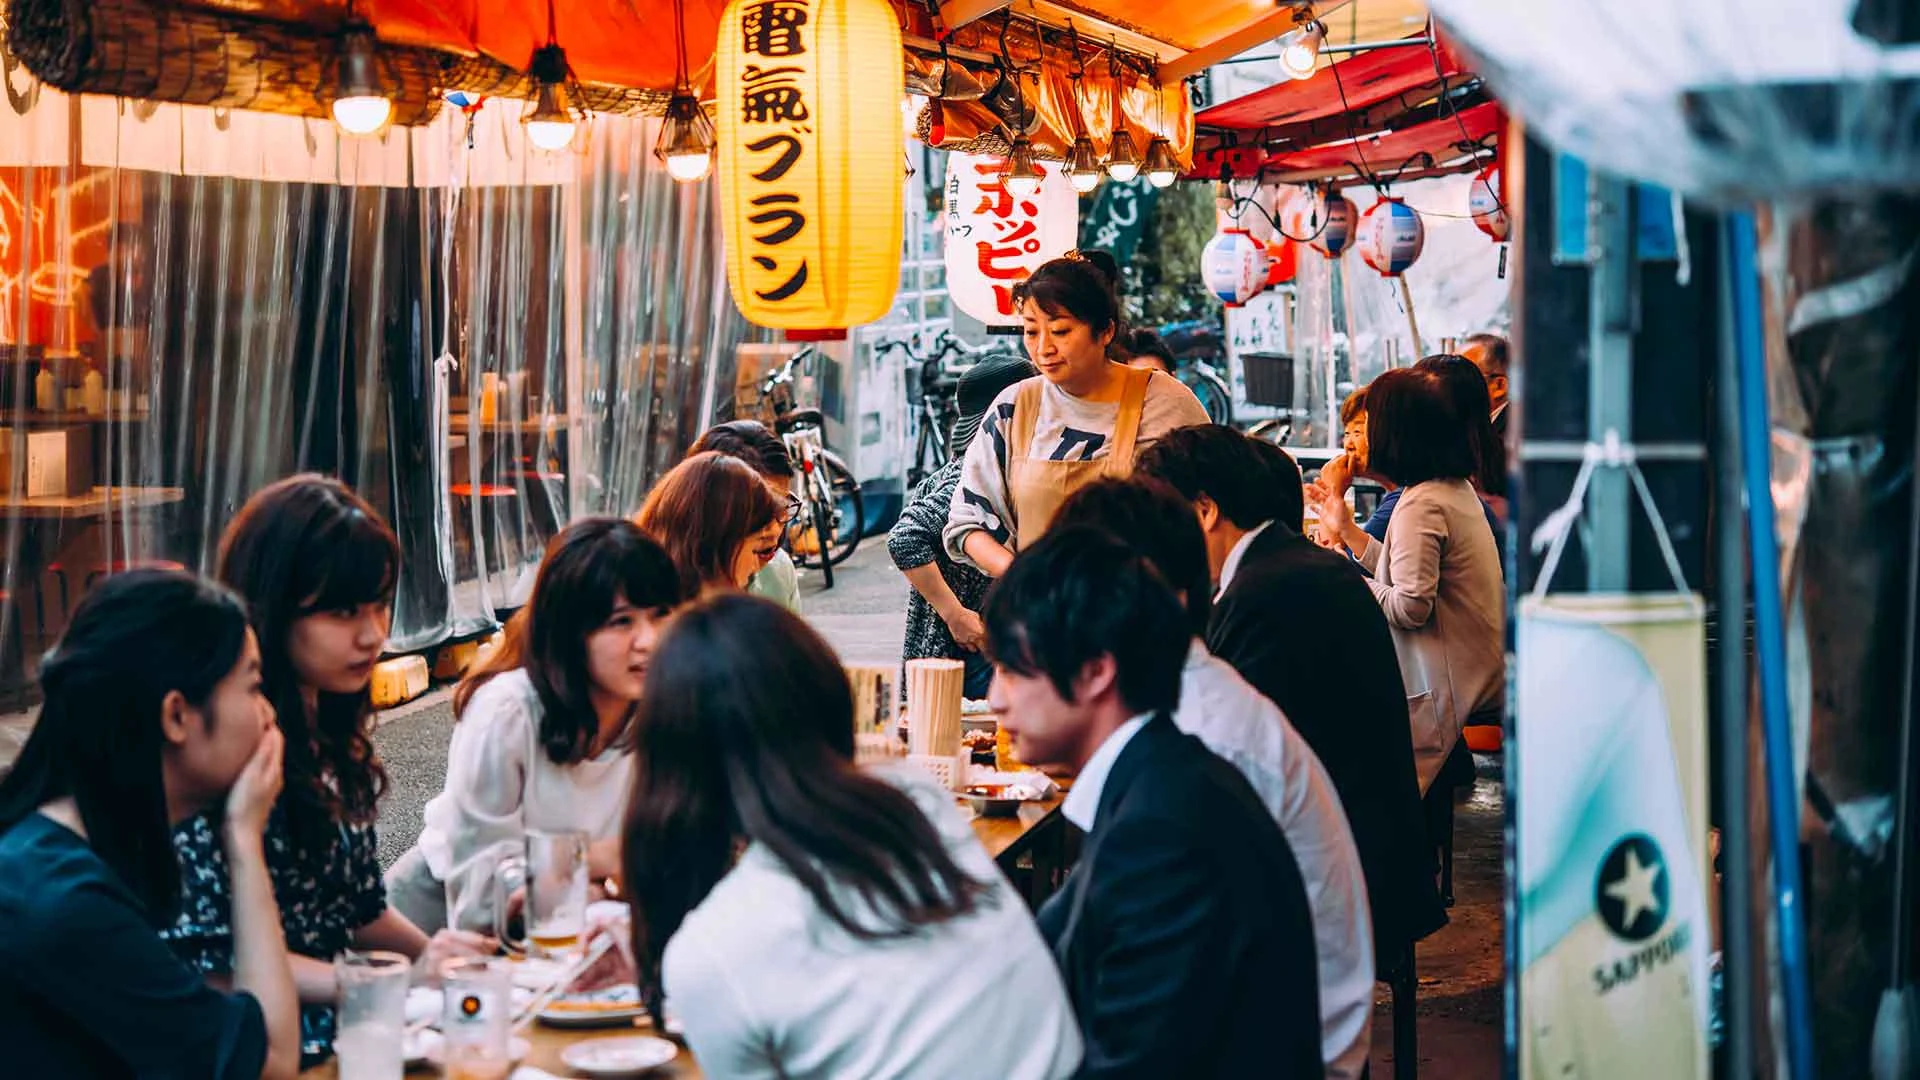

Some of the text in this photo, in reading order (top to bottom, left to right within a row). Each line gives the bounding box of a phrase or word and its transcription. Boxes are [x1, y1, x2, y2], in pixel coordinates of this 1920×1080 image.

[742, 0, 812, 301] 電氣ブラン
